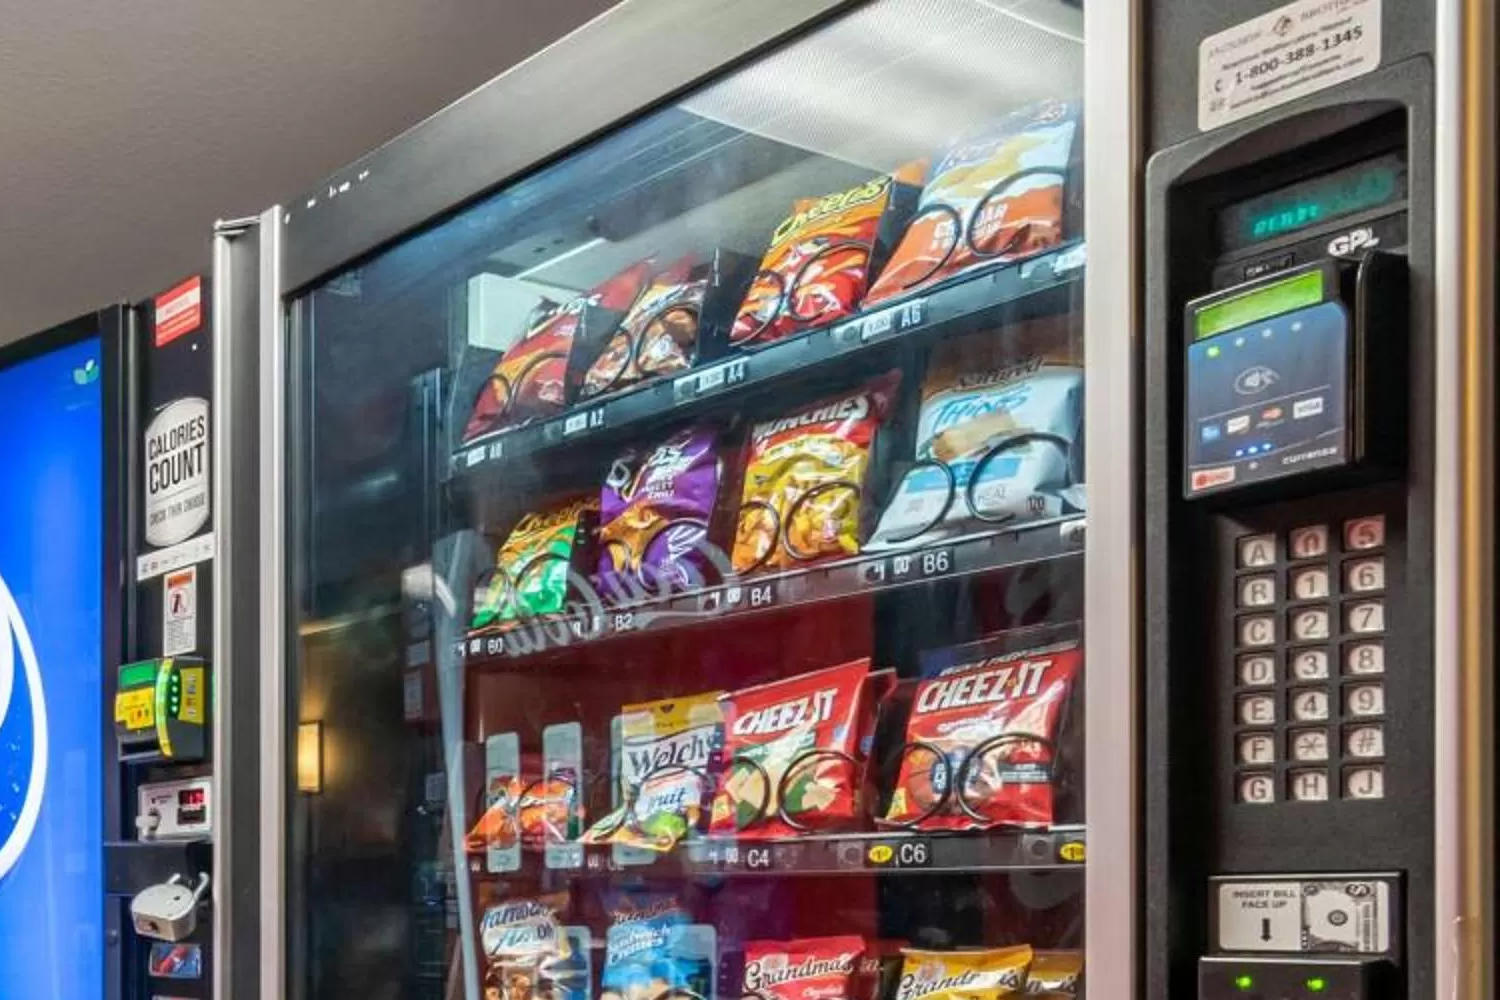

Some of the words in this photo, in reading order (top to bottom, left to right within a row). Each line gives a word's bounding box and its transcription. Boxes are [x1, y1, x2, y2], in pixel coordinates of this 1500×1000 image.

[1328, 227, 1380, 257] GPL
[148, 415, 205, 461] CALORIES
[149, 441, 205, 494] COUNT
[924, 552, 949, 573] B6
[1251, 543, 1266, 565] A
[1306, 574, 1316, 595] 1
[1359, 568, 1374, 588] 6
[751, 585, 773, 604] B4
[1304, 615, 1318, 635] 2
[1361, 608, 1374, 630] 7
[1251, 621, 1266, 641] C
[1303, 655, 1317, 676] 3
[1359, 648, 1374, 669] 8
[1251, 661, 1266, 681] D
[1303, 695, 1318, 714] 4
[1359, 688, 1374, 710] 9
[1252, 700, 1265, 720] E
[1252, 740, 1264, 760] F
[1251, 779, 1266, 800] G
[1302, 776, 1318, 796] H
[1359, 772, 1373, 795] J
[747, 848, 770, 867] C4
[900, 842, 926, 864] C6
[1241, 900, 1271, 910] FACE
[1274, 899, 1288, 910] UP
[1273, 888, 1297, 900] BILL
